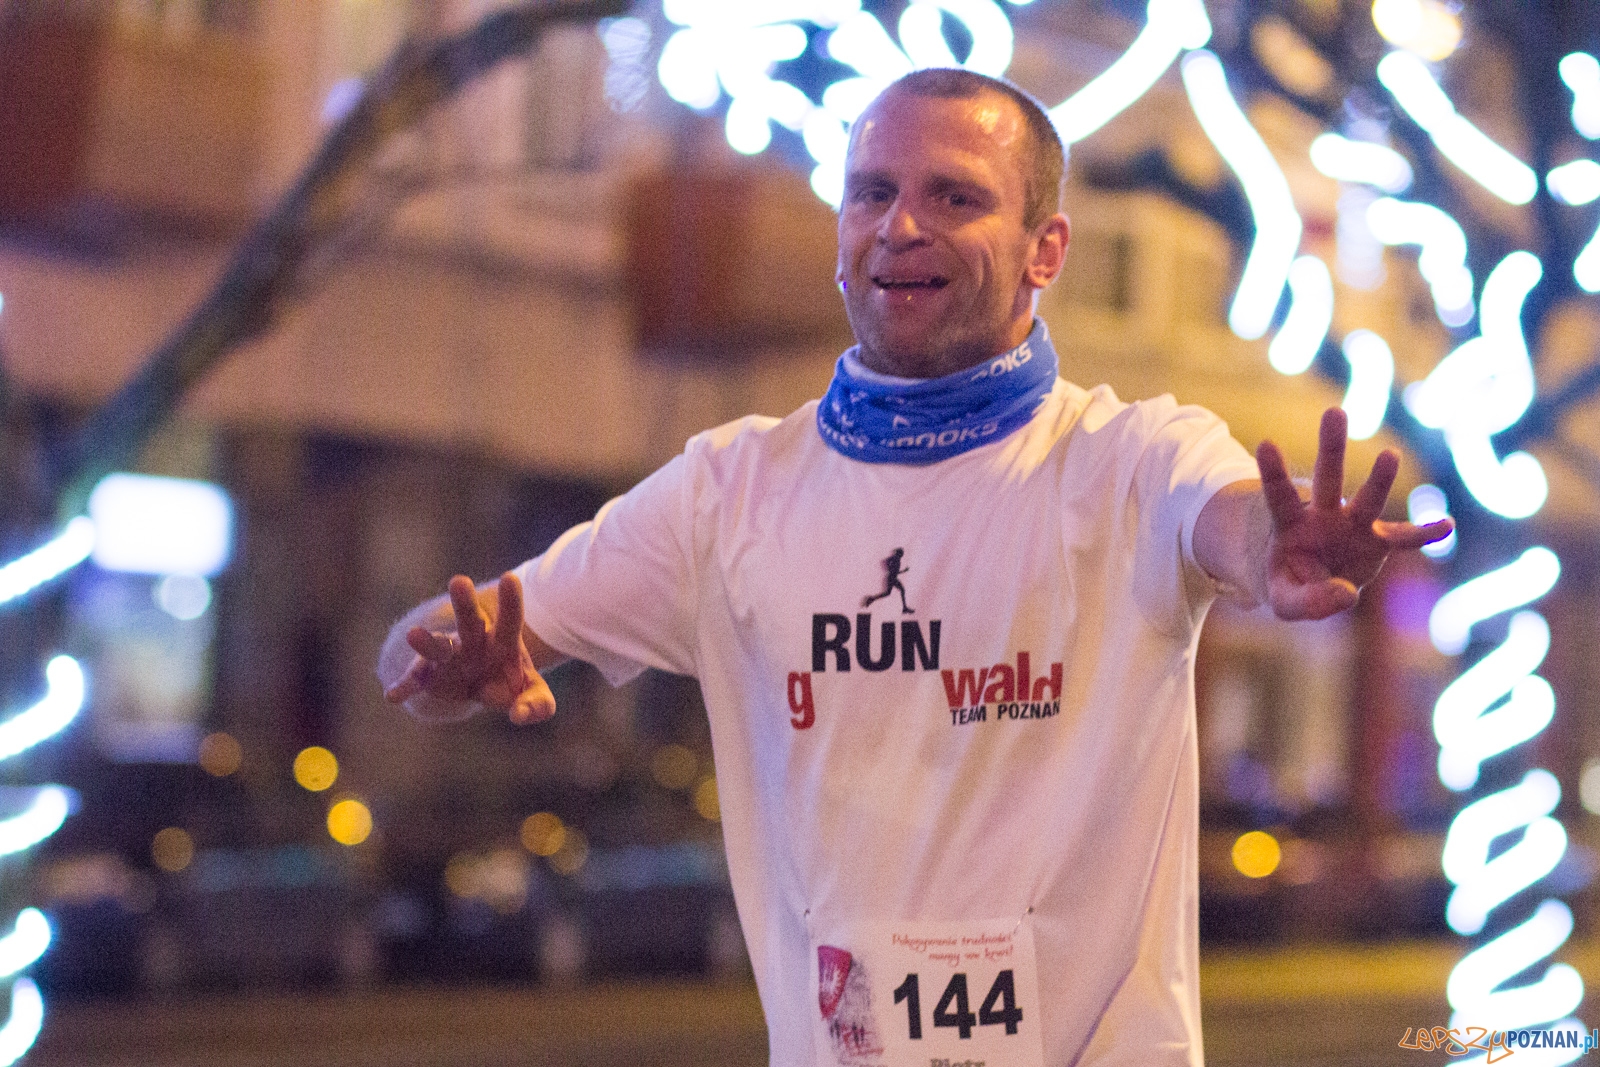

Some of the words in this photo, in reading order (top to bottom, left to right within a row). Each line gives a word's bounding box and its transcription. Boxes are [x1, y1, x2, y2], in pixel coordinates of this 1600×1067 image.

[811, 612, 942, 672] RUN
[787, 671, 816, 731] g
[941, 651, 1063, 710] wald
[951, 705, 987, 726] TEAM
[893, 969, 1023, 1040] 144
